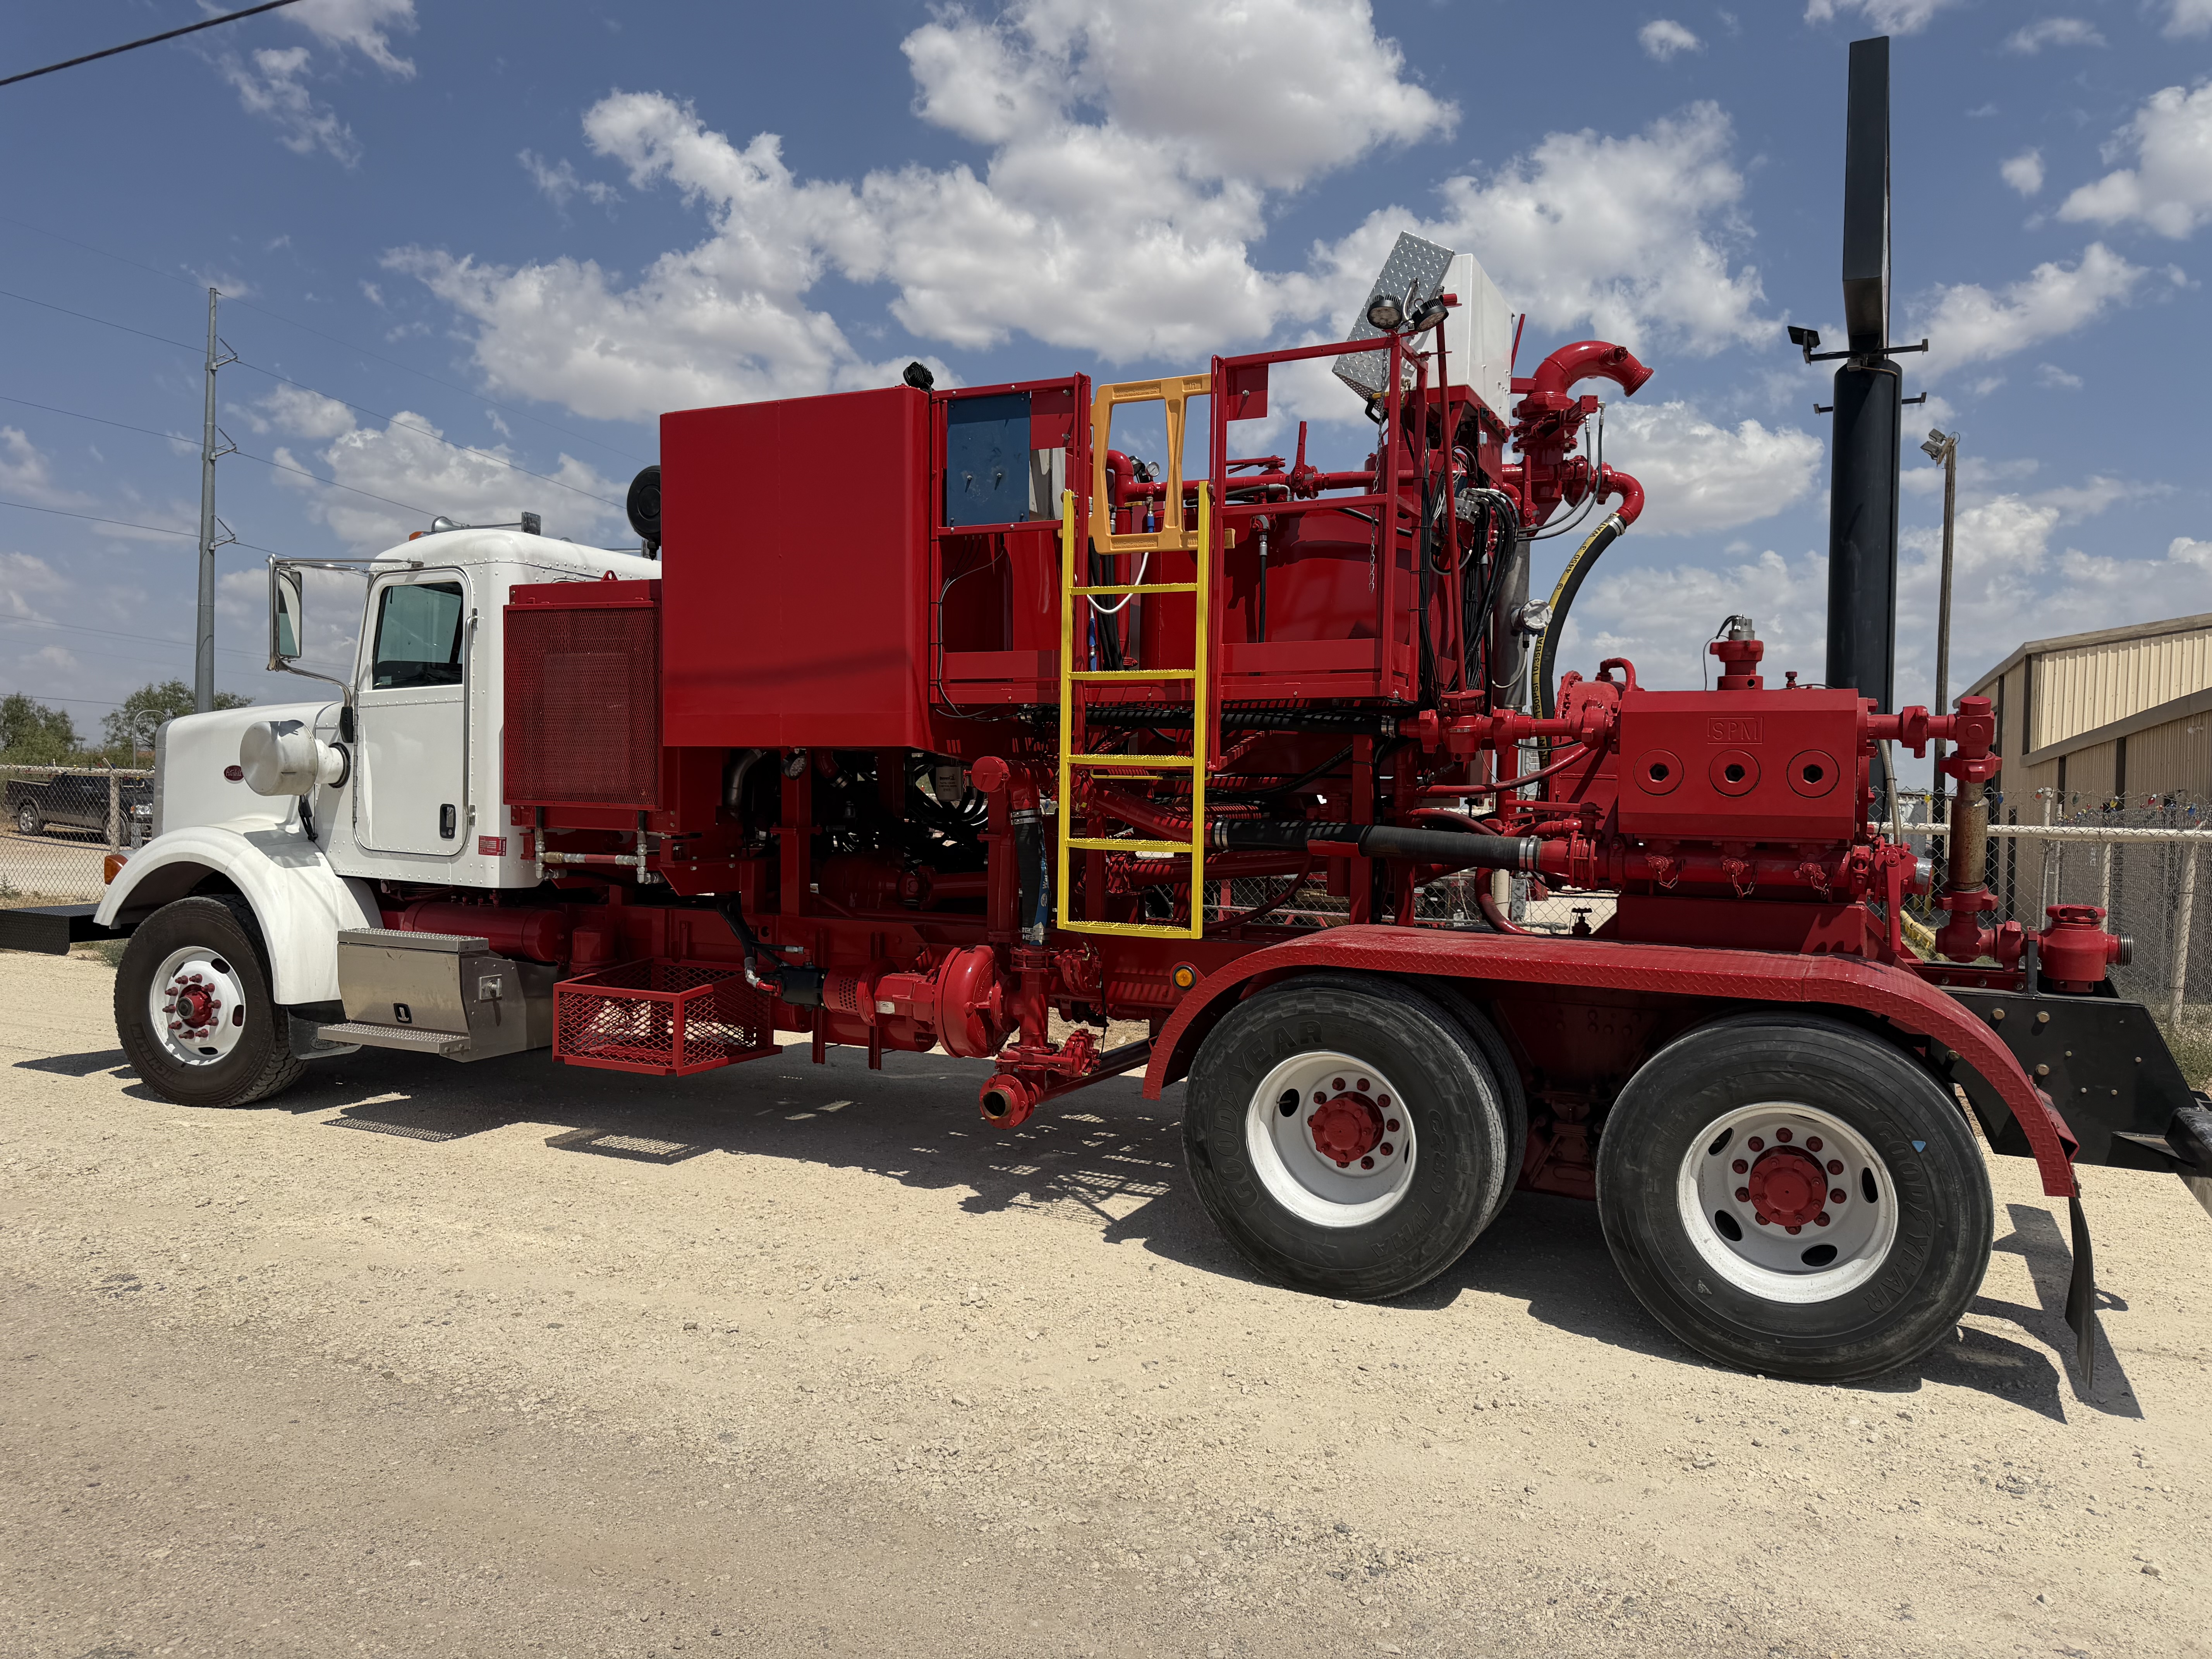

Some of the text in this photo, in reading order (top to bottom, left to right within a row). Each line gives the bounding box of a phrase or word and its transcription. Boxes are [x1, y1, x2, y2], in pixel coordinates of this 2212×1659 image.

[1566, 555, 1580, 574] 4450
[1534, 635, 1544, 675] 10.35BA
[1533, 682, 1541, 714] 150PSI
[1713, 721, 1758, 740] SPM
[131, 1023, 182, 1087] MICHELIN
[1212, 1020, 1324, 1209] GOODYEAR
[1370, 1201, 1432, 1258] WHA
[1863, 1121, 1934, 1314] GOODYEAR
